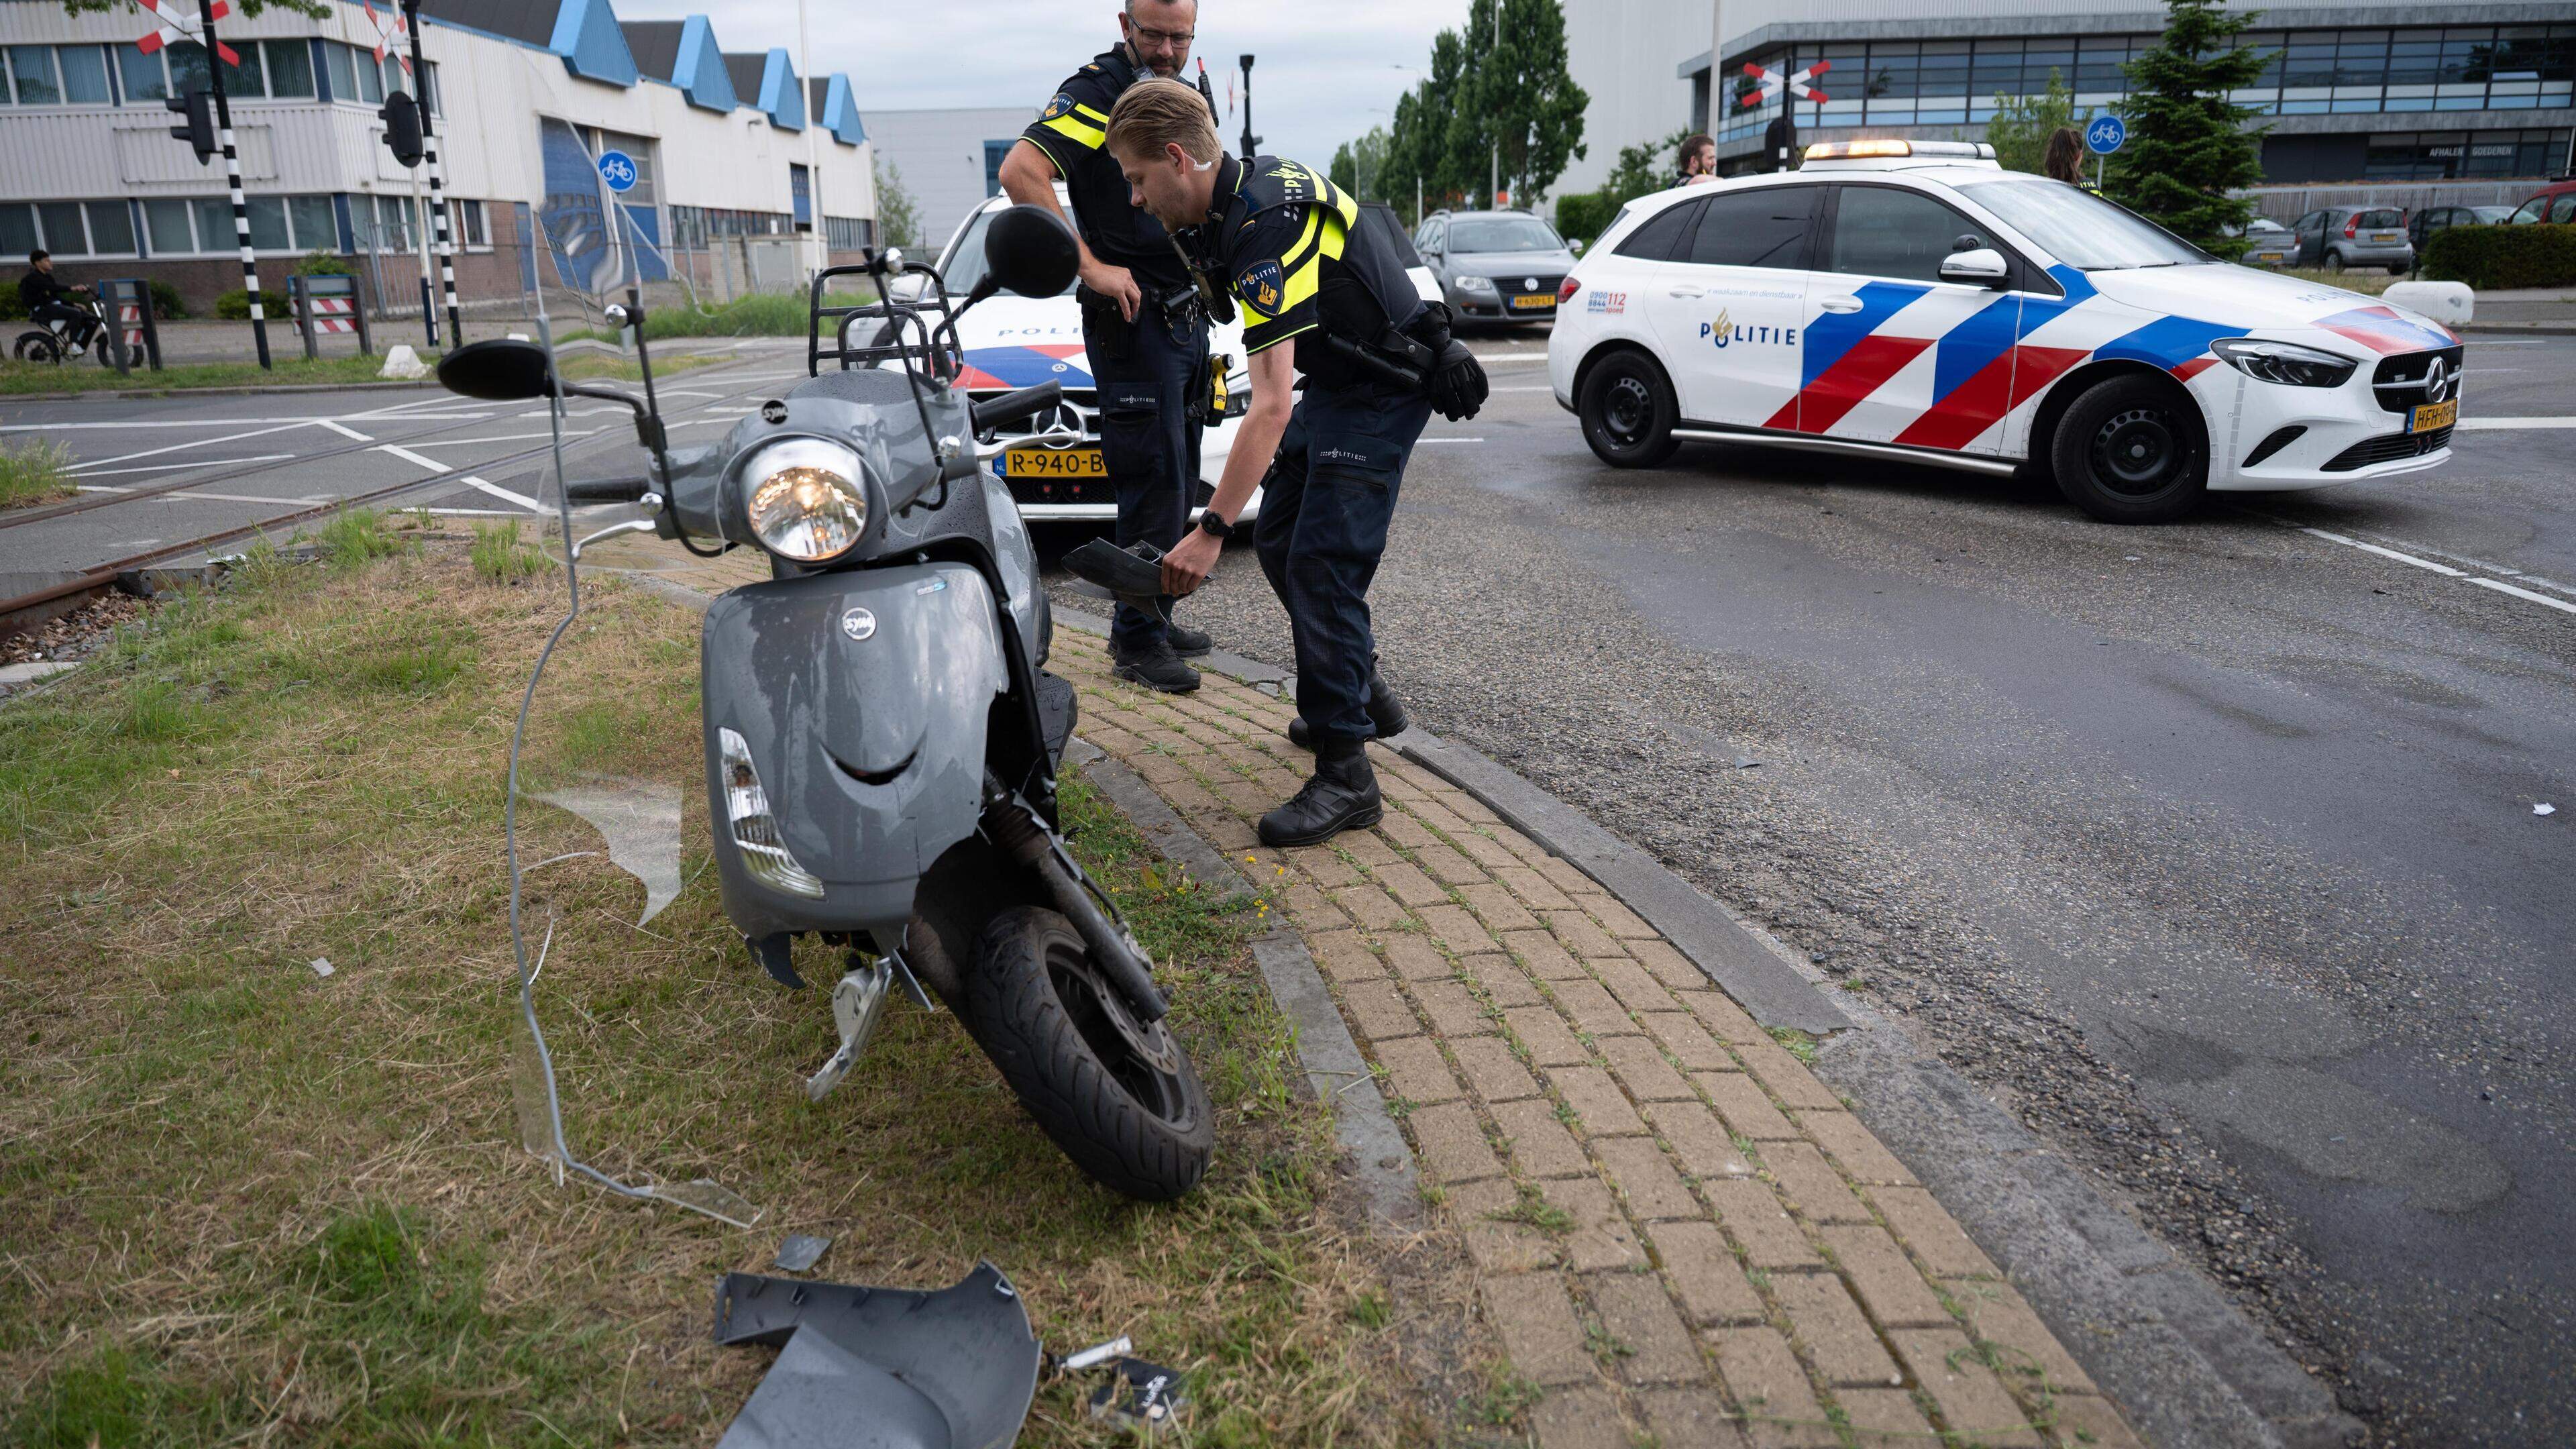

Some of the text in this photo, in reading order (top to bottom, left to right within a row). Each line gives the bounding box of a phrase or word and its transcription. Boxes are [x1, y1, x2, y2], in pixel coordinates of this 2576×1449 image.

[2429, 146, 2512, 157] AFHALEN GOEDEREN
[1242, 266, 1277, 286] POLITIE
[1590, 291, 1608, 299] 0900
[1609, 292, 1626, 306] 112
[1700, 322, 1796, 348] POLITIE
[762, 407, 788, 421] SYM
[1328, 450, 1358, 460] POLITIE
[1012, 453, 1104, 474] R-940-B
[845, 616, 874, 632] SYM
